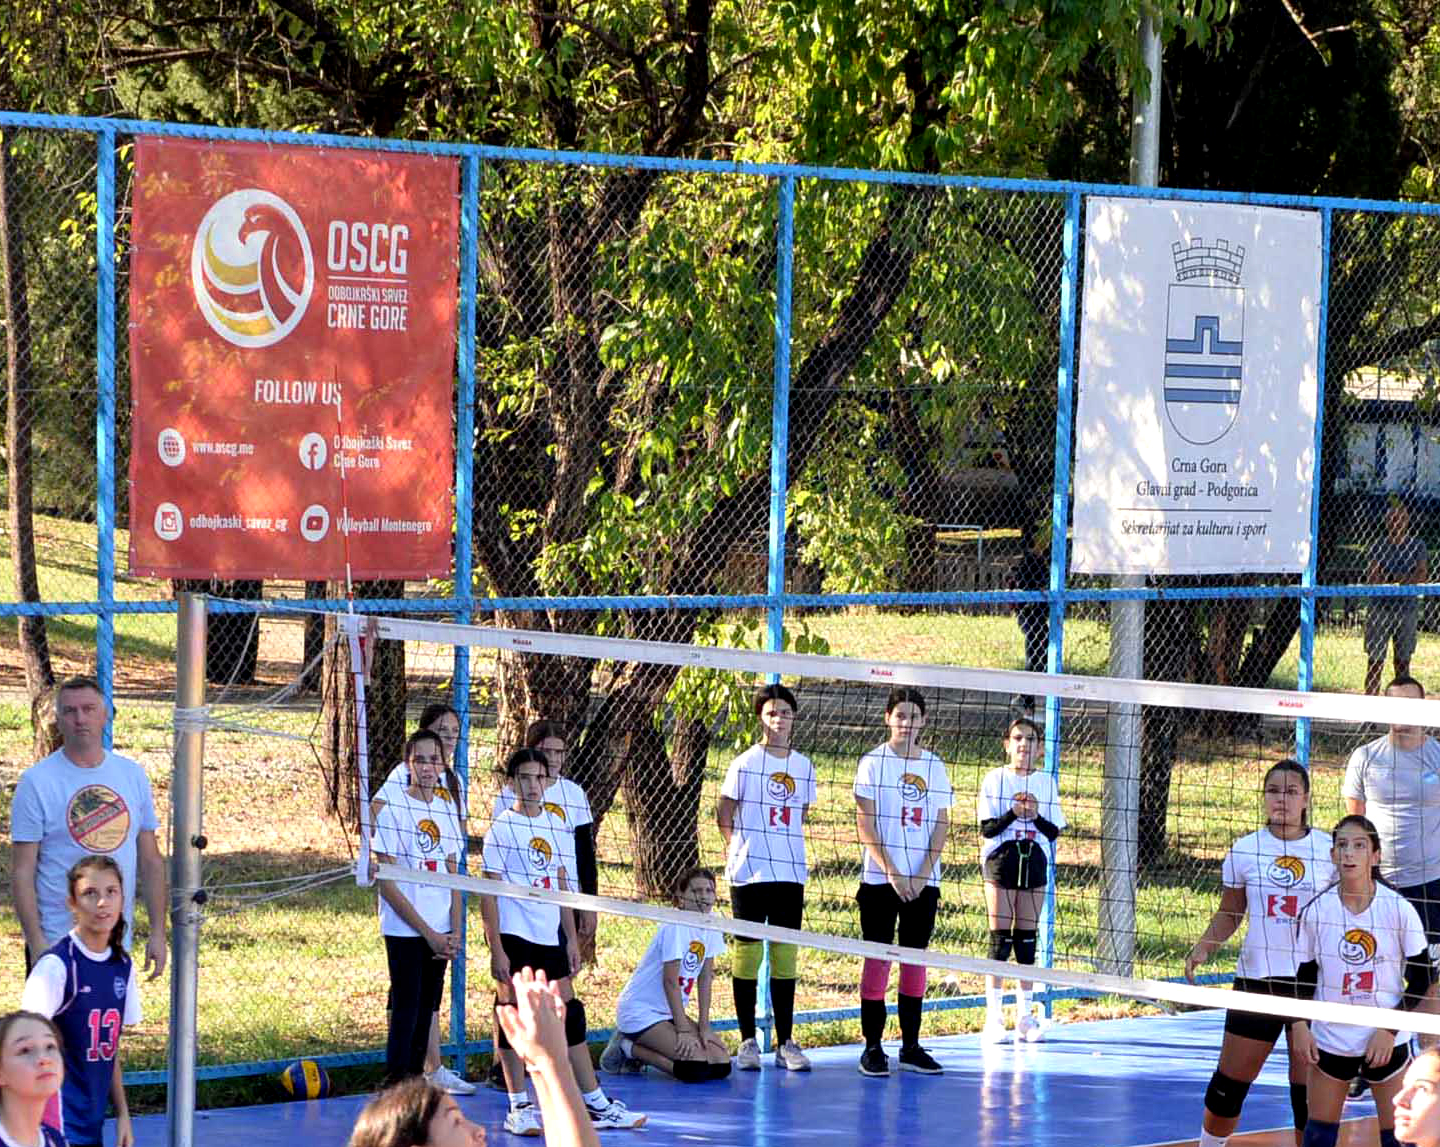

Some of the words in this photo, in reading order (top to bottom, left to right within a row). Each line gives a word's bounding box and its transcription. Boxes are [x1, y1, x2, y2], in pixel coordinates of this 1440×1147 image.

[327, 220, 409, 274] OSCG
[381, 287, 408, 303] SAVEZ
[327, 303, 366, 329] CRNE
[370, 305, 408, 331] GORE
[254, 379, 317, 404] FOLLOW
[321, 382, 342, 405] US
[1171, 457, 1197, 473] Crna
[1200, 457, 1227, 473] Gora
[1136, 480, 1171, 497] Glavni
[1174, 481, 1196, 500] grad
[1207, 482, 1258, 502] Podgorica
[1121, 520, 1180, 537] Sekretarijat
[1182, 525, 1194, 536] za
[1195, 520, 1234, 536] kulturu
[1242, 522, 1267, 541] sport
[86, 1008, 121, 1062] 13
